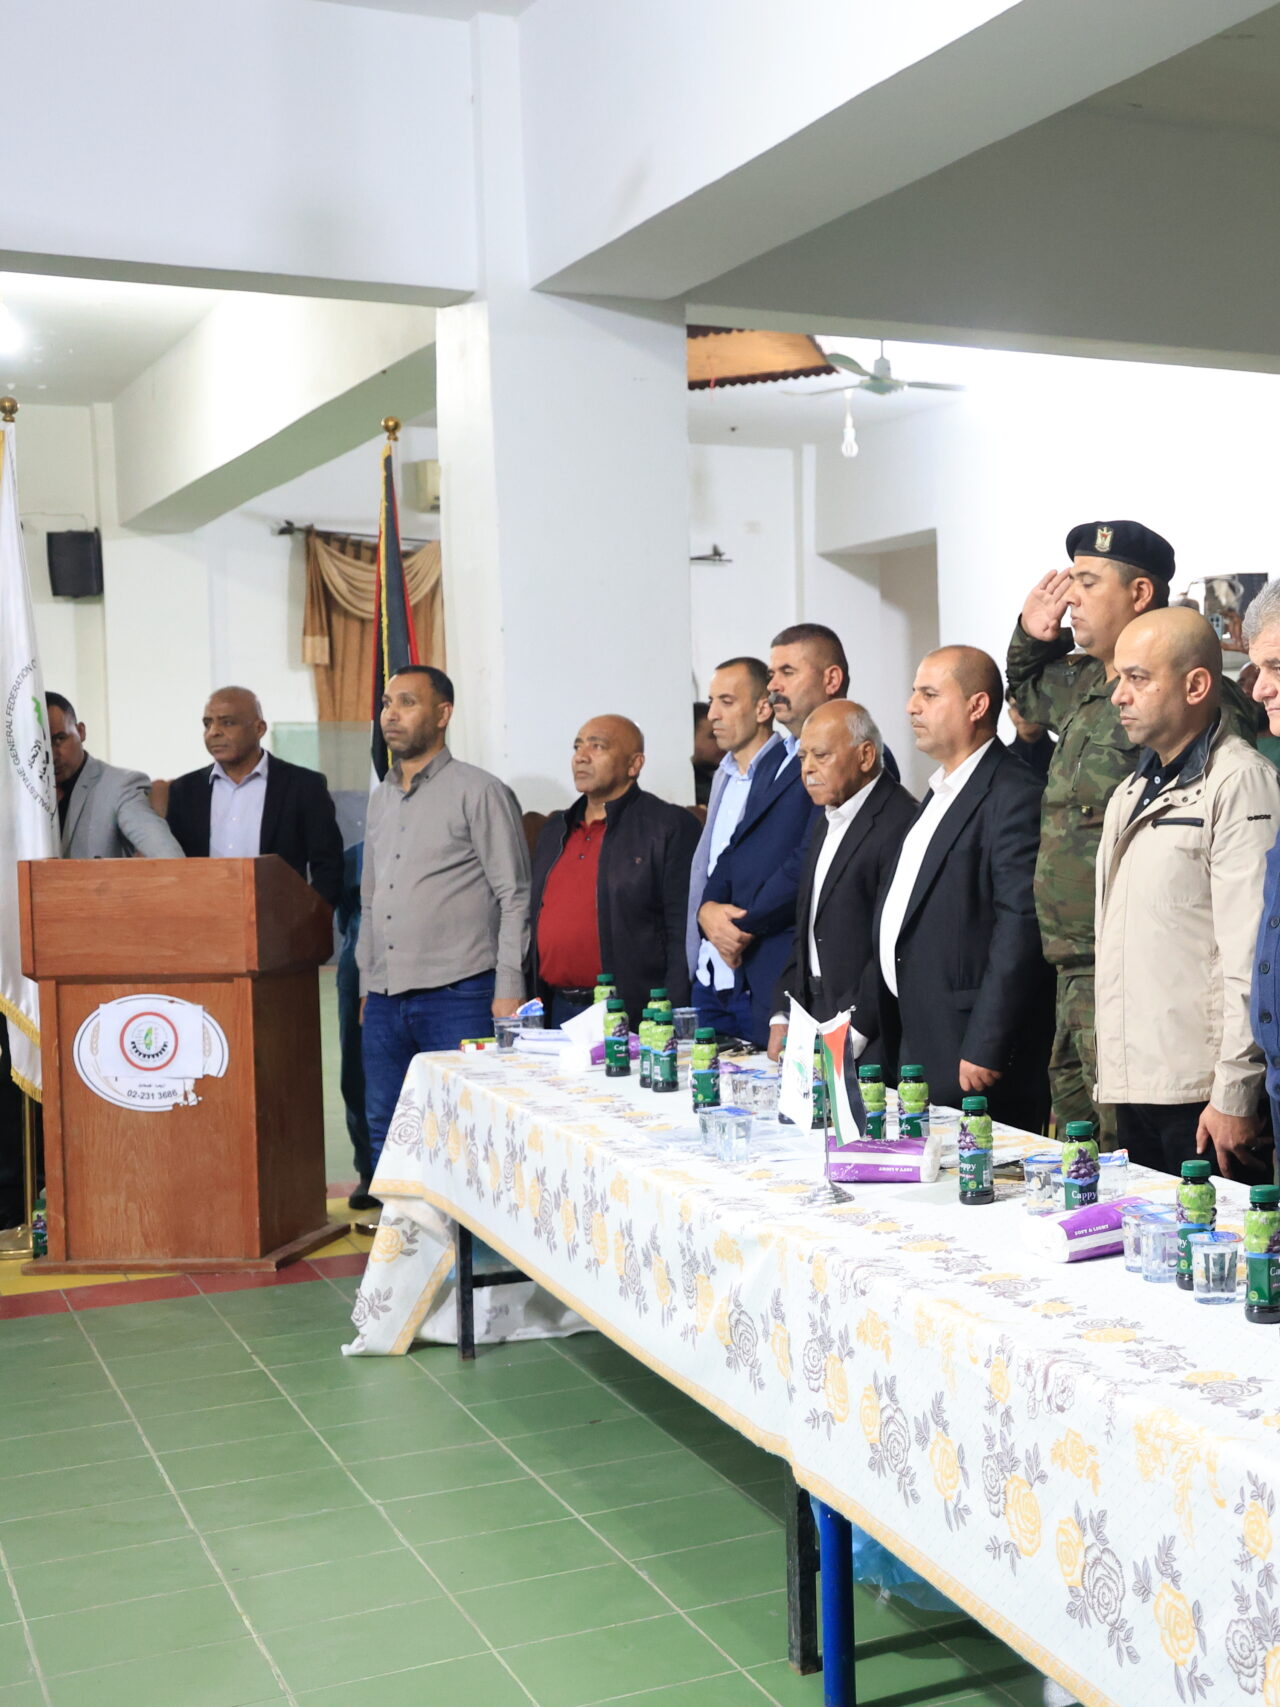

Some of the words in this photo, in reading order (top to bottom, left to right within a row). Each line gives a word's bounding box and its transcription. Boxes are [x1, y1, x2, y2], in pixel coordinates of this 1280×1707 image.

[6, 664, 33, 717] FEDERATION
[6, 719, 20, 766] GENERAL
[1071, 1190, 1097, 1200] Cappy
